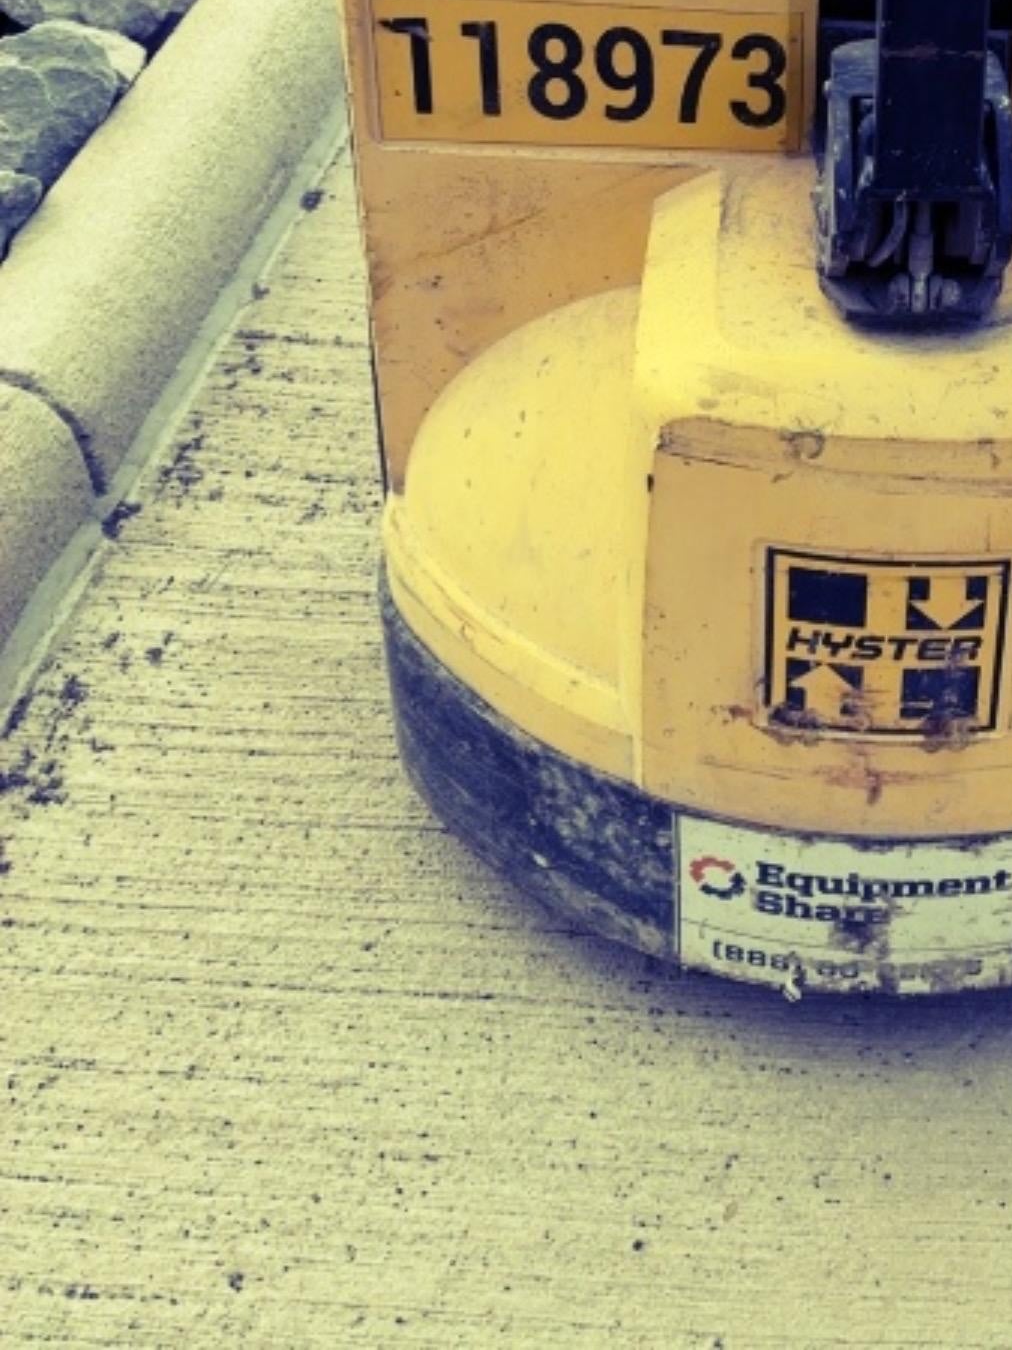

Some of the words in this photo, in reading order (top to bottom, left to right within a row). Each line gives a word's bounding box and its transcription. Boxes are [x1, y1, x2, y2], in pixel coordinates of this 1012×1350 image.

[379, 18, 787, 128] 118973
[786, 627, 983, 661] HYSTER
[756, 860, 1012, 901] Equipment
[756, 890, 892, 924] Share
